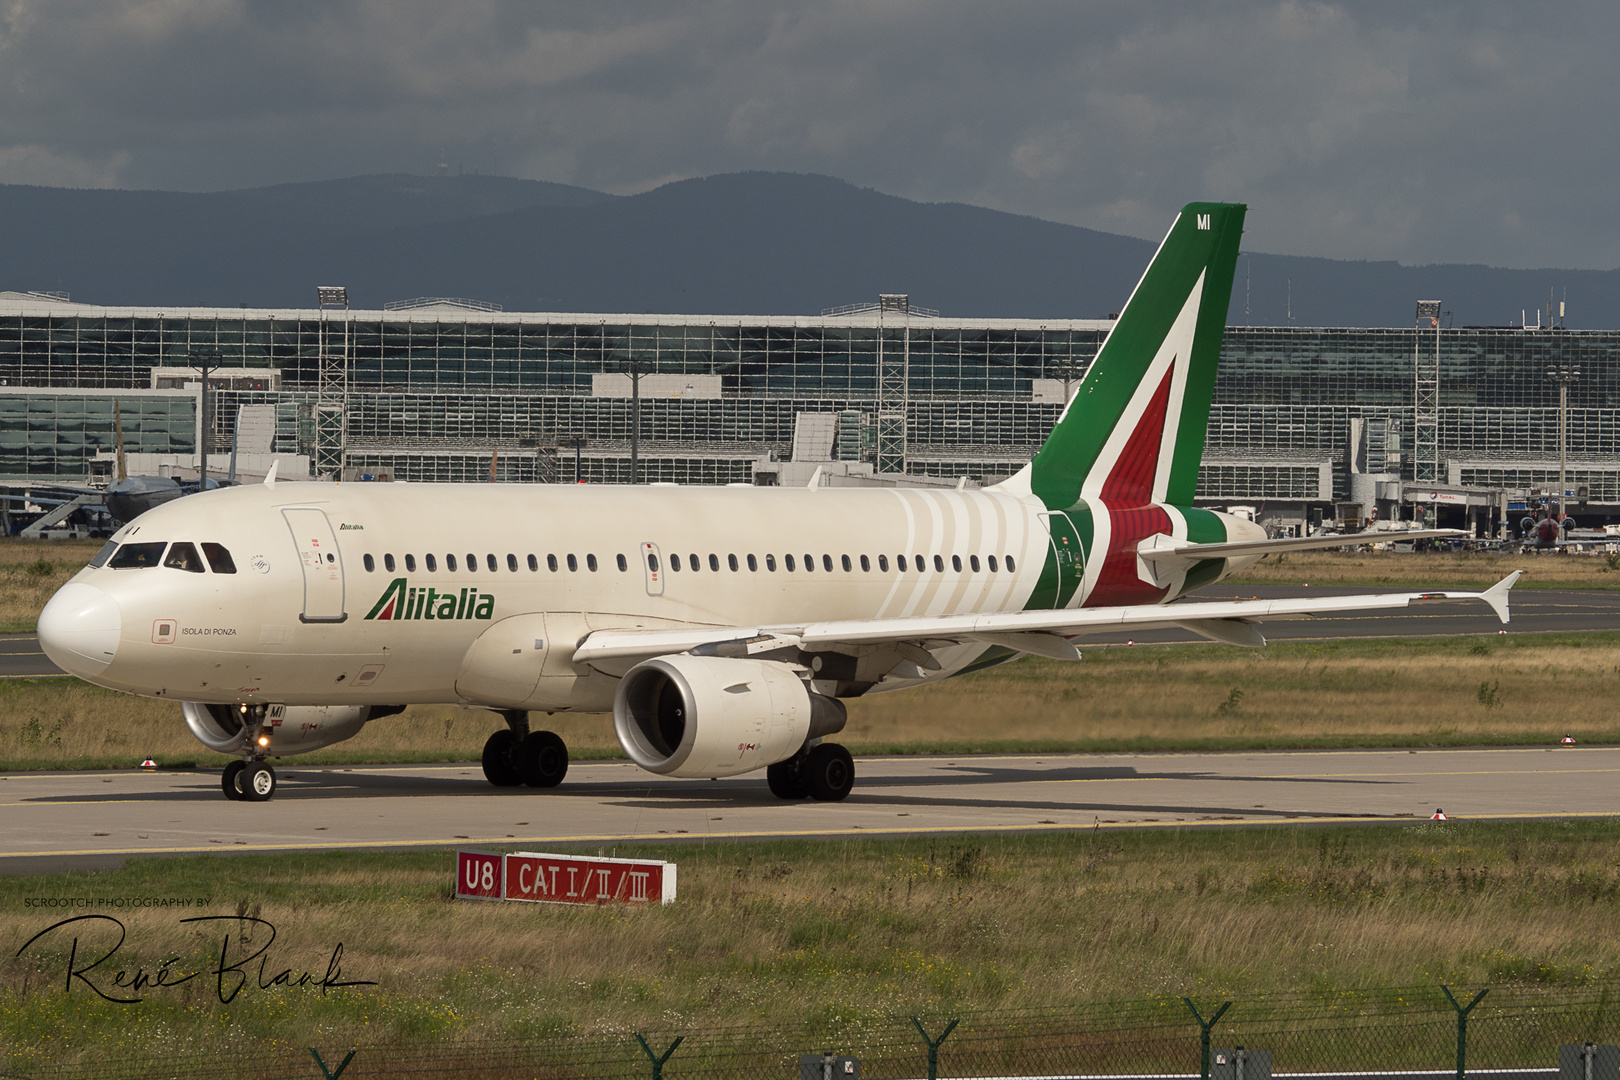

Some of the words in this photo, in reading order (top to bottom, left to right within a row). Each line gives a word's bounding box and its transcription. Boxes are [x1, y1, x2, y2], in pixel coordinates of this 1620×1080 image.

[1197, 213, 1210, 230] MI
[339, 523, 364, 531] Alitalia
[363, 577, 495, 620] Alitalia
[181, 628, 203, 636] ISOLA
[270, 705, 284, 718] MI
[466, 860, 494, 891] U8
[519, 863, 560, 896] CAT
